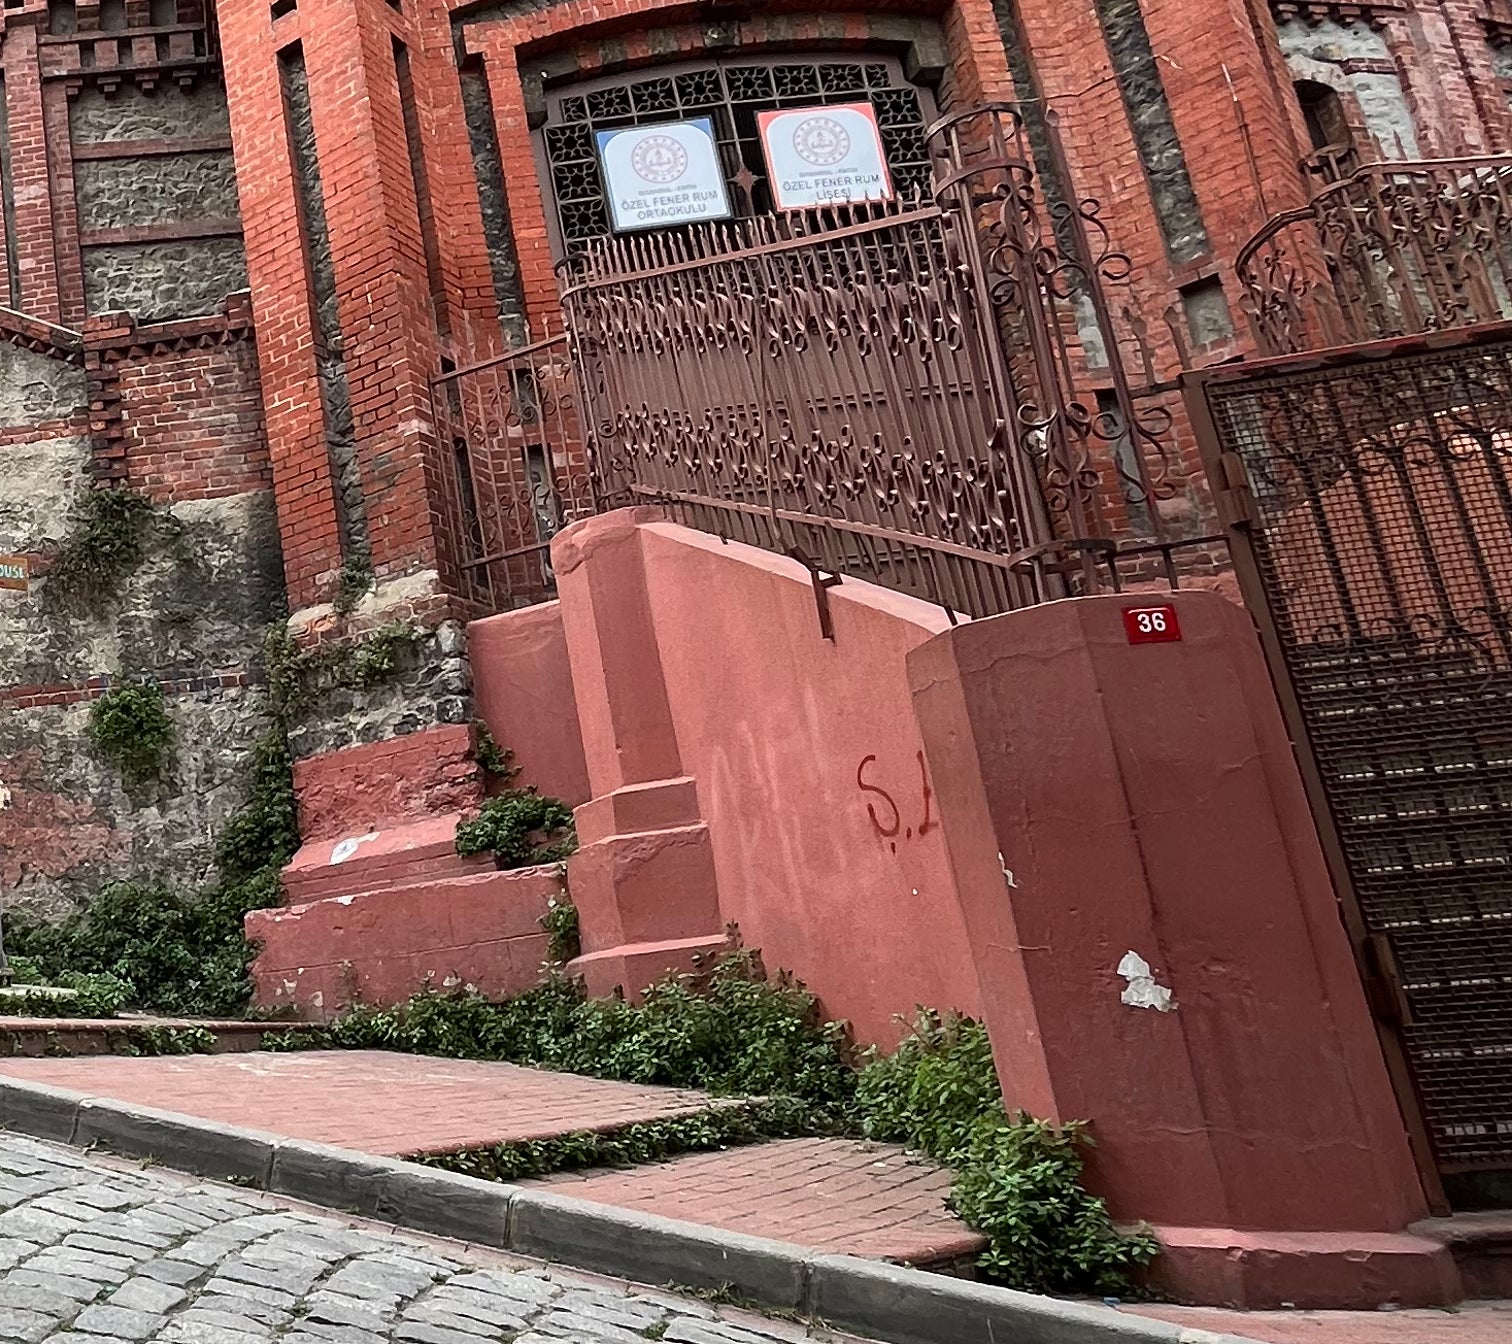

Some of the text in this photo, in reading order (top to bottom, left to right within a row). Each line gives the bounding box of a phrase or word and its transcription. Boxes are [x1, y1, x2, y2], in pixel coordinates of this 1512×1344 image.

[783, 173, 880, 191] ÖZEL FENER RUM
[621, 198, 651, 211] ÖZEL
[653, 194, 690, 207] FENER
[693, 189, 719, 202] RUM
[637, 203, 707, 221] ORTAOKULU
[1137, 612, 1166, 633] 36
